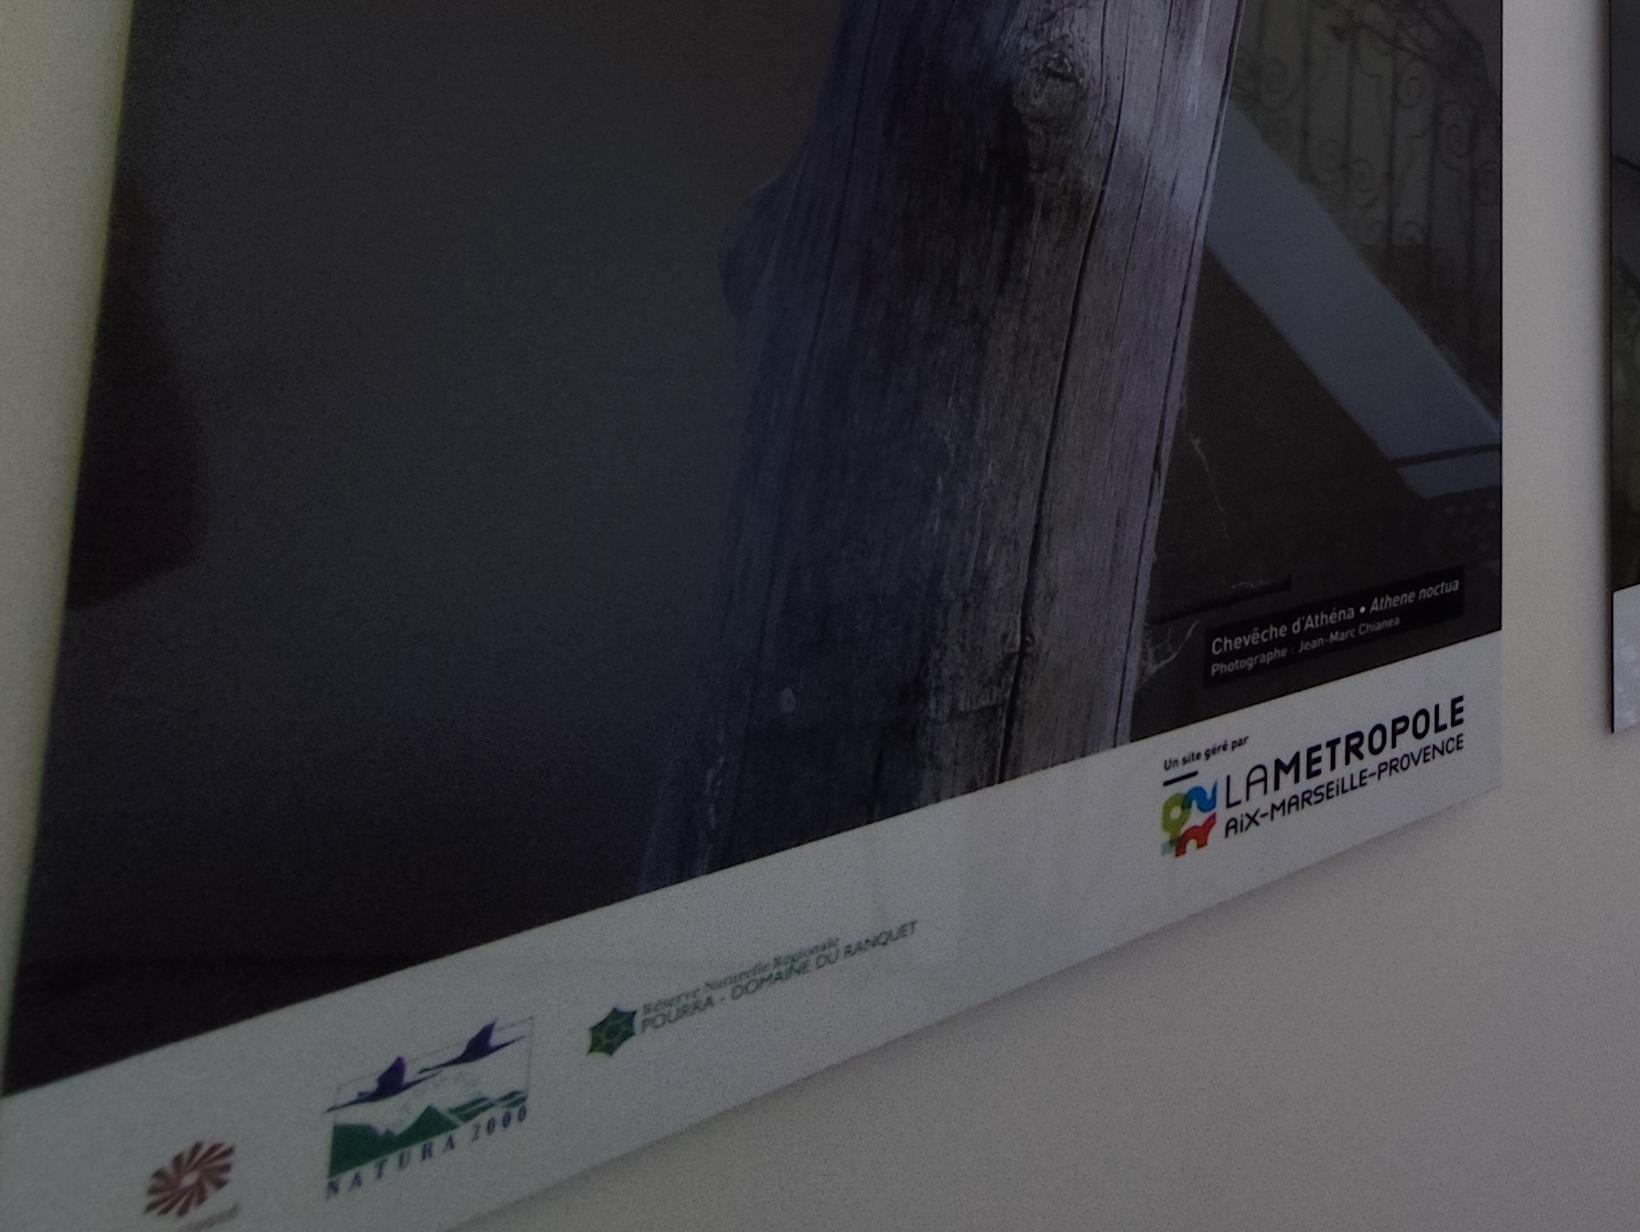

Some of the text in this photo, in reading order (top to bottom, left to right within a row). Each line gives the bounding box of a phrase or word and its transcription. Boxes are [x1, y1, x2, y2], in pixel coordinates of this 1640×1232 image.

[1210, 645, 1287, 677] Photographe
[1297, 627, 1355, 654] Jean-Marc
[1211, 578, 1459, 656] Chevêche d'Athéna Athene noctua
[1163, 735, 1249, 771] Un site géré par
[1225, 695, 1464, 809] LAMETROPOLE
[731, 960, 811, 1001] DOMAINE
[815, 949, 839, 970] DU
[844, 920, 919, 959] RANQUET
[326, 1104, 528, 1201] NATURA 2000
